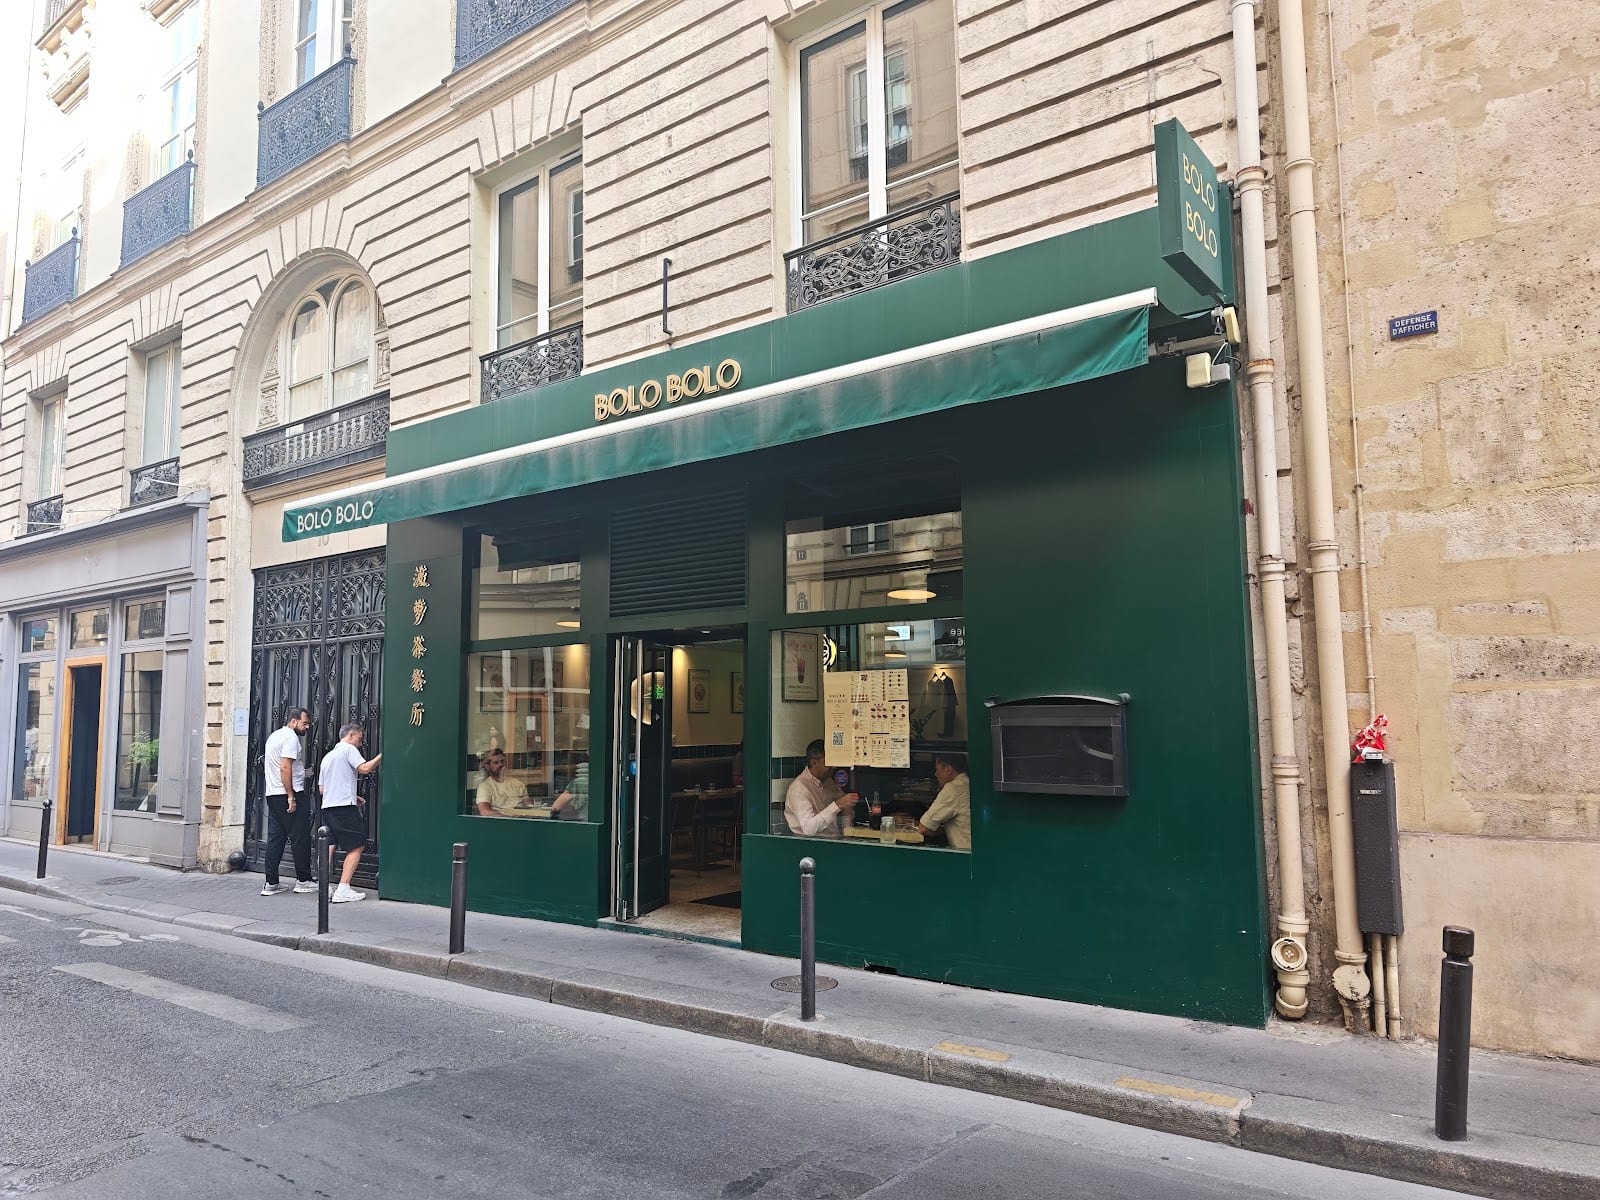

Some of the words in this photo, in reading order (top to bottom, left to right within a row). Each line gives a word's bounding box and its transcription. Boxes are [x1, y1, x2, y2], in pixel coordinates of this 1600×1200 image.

[1183, 154, 1215, 213] BOLO
[1186, 201, 1218, 258] BOLO
[1392, 321, 1436, 336] D'AFFICHER
[1395, 314, 1432, 328] DEFENSE
[595, 380, 662, 421] BOLO
[666, 358, 741, 404] BOLO
[296, 508, 332, 534] BOLO
[335, 500, 374, 525] BOLO
